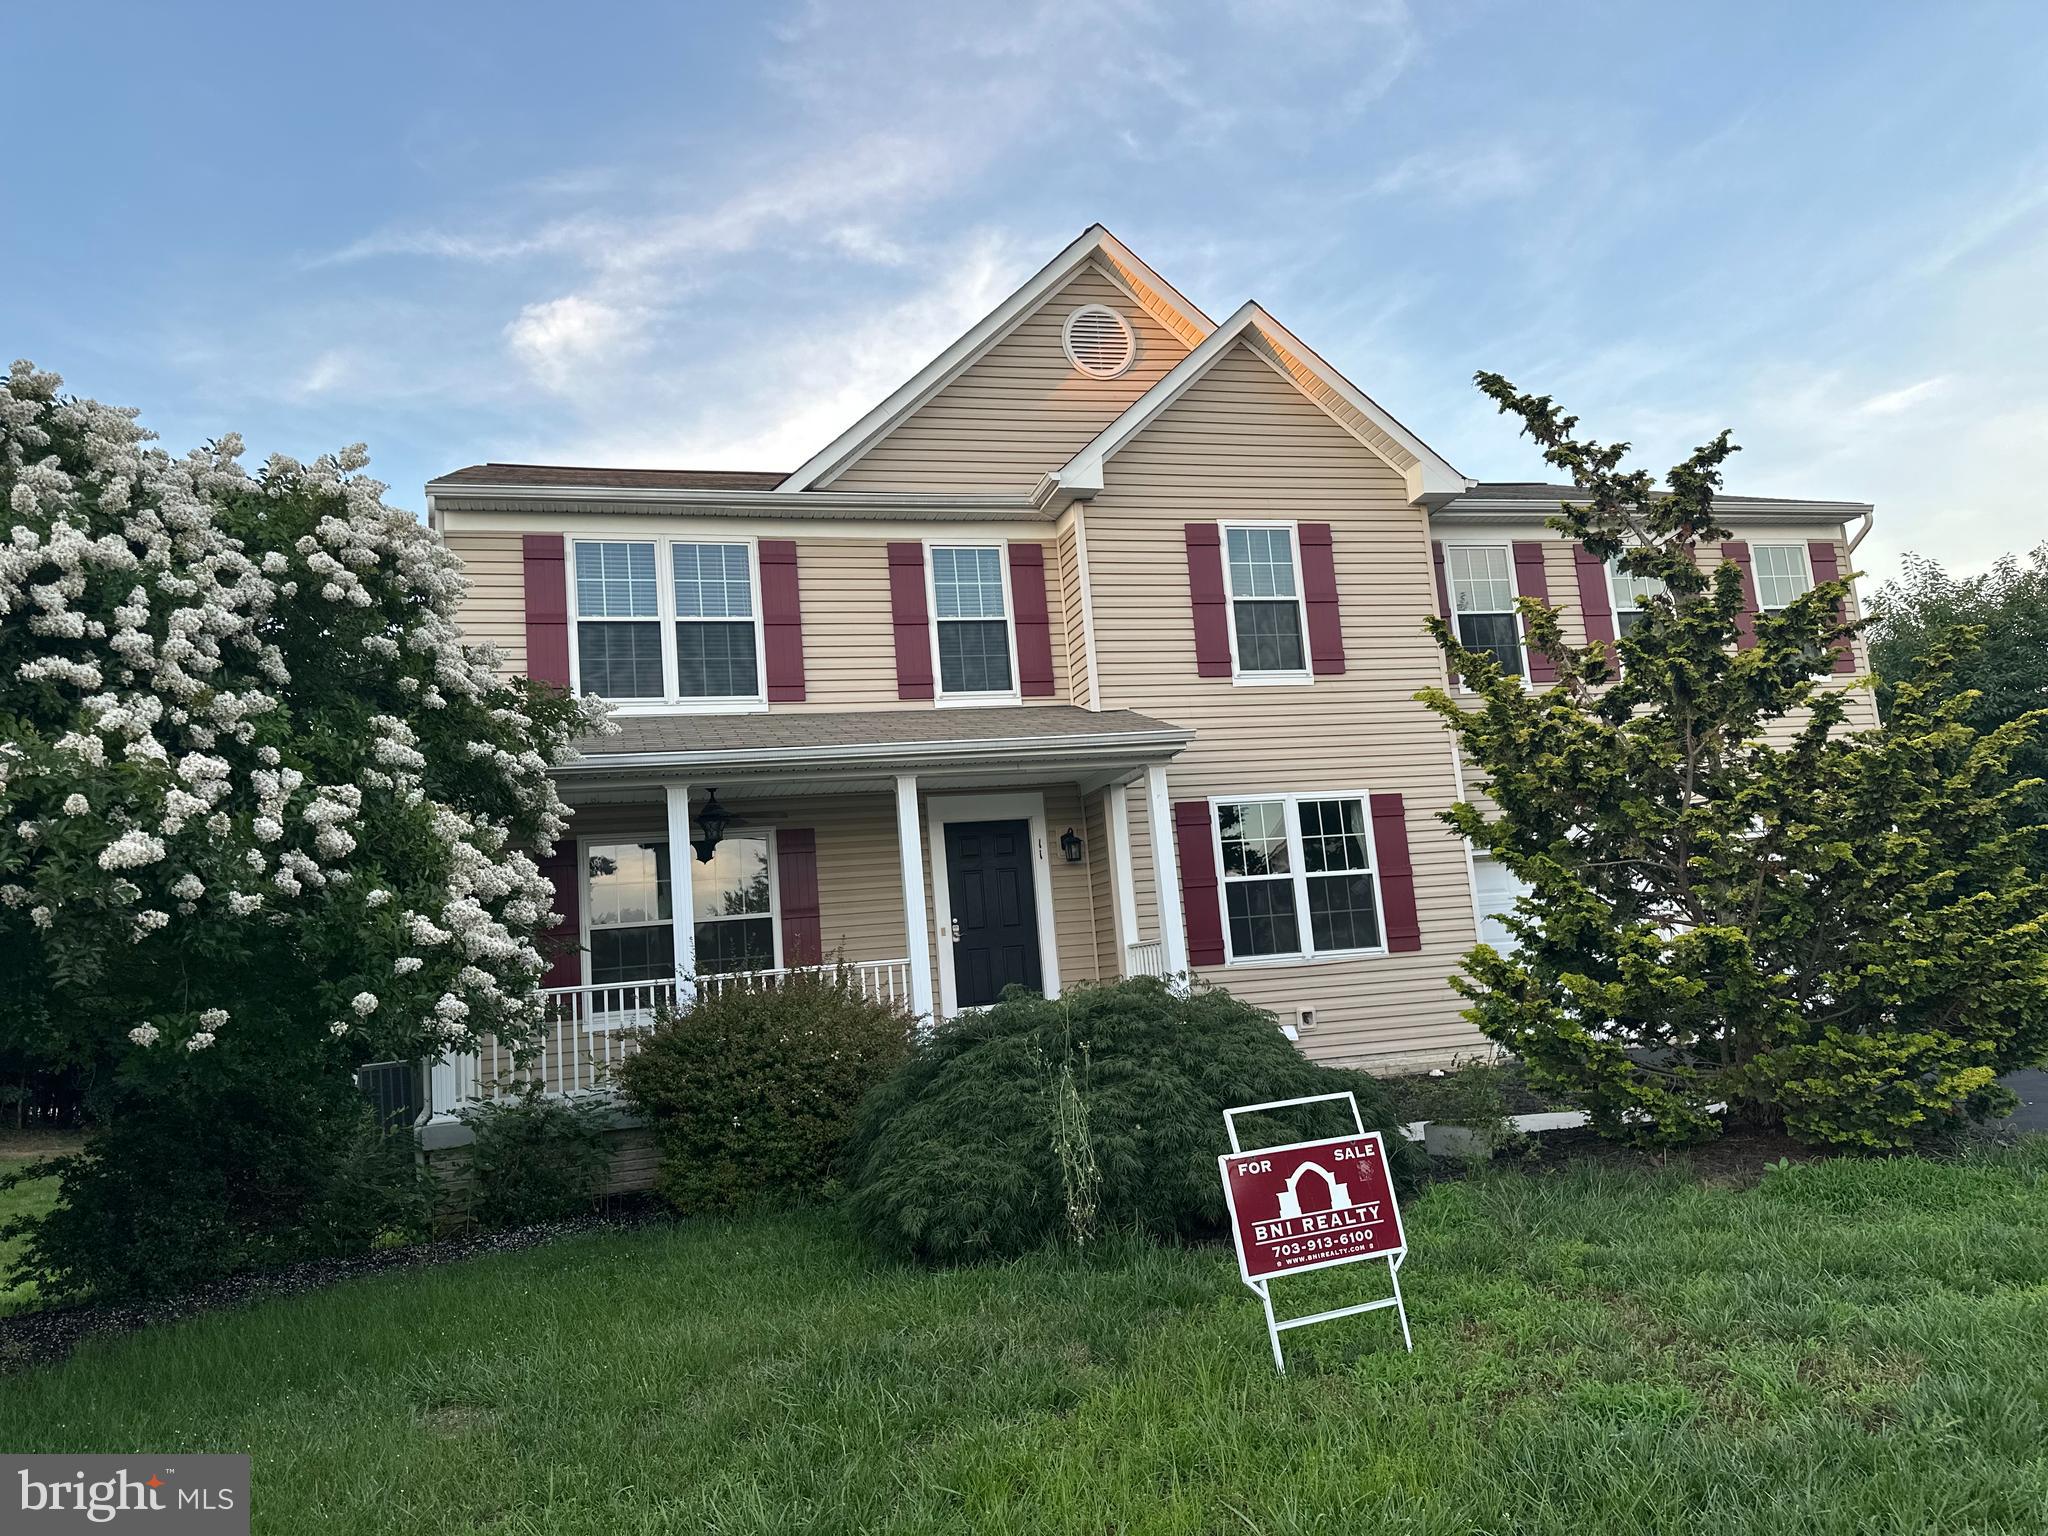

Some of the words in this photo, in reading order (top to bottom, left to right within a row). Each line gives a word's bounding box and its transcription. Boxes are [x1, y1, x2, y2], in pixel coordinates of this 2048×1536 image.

[1237, 1160, 1272, 1177] FOR
[1333, 1144, 1375, 1161] SALE
[1254, 1223, 1293, 1241] BNI
[1302, 1205, 1380, 1232] REALTY
[1271, 1229, 1373, 1258] 703-913-6100
